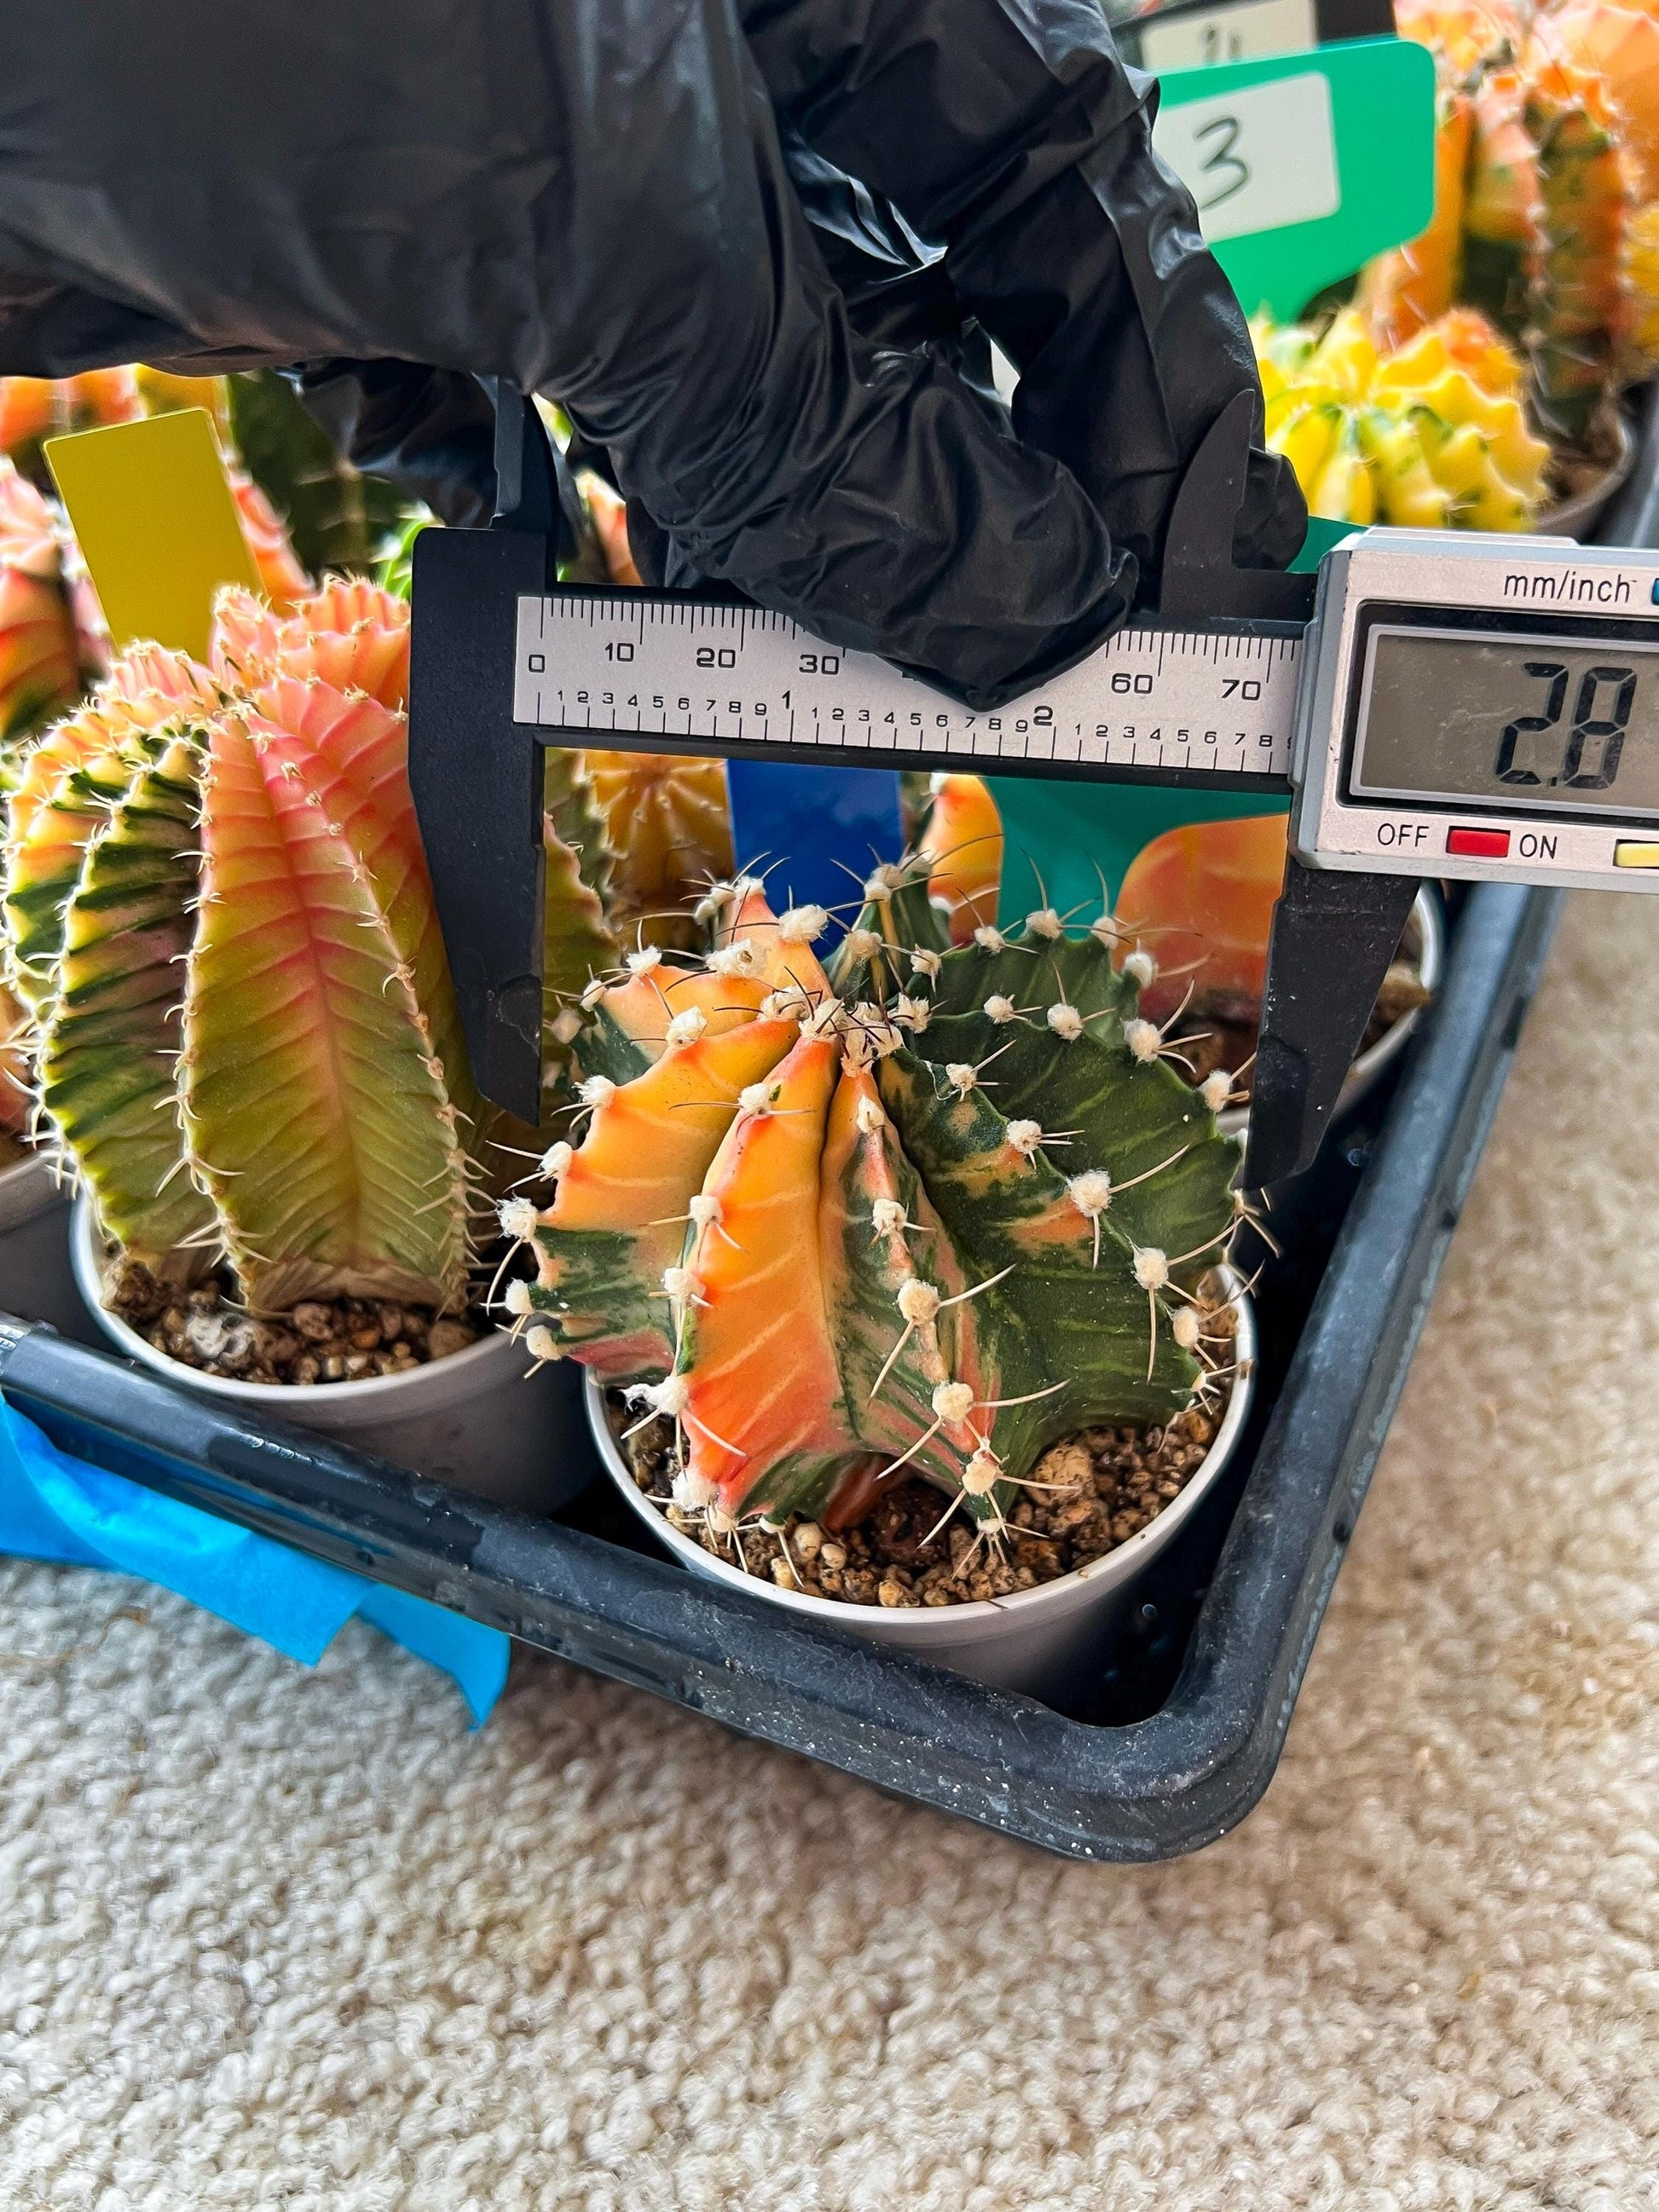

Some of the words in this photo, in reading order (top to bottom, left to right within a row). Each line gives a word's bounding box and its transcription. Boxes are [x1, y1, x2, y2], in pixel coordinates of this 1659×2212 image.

[1194, 116, 1250, 211] 3
[1503, 569, 1631, 604] mm/inch
[528, 654, 546, 673] 0
[604, 642, 635, 662] 10
[696, 647, 737, 669] 20
[799, 654, 840, 676] 30
[1111, 673, 1153, 695] 60
[1221, 679, 1262, 702] 70
[577, 690, 589, 704] 2
[602, 692, 614, 705] 3
[627, 694, 639, 707] 4
[652, 695, 664, 708] 5
[678, 697, 690, 711] 6
[706, 699, 717, 712] 7
[728, 701, 742, 713] 8
[754, 702, 767, 716] 9
[781, 690, 791, 710] 1
[831, 707, 845, 721] 2
[858, 709, 870, 722] 3
[883, 711, 895, 725] 4
[910, 713, 922, 726] 5
[935, 714, 949, 728] 6
[965, 715, 976, 729] 7
[988, 717, 1003, 731] 8
[1014, 719, 1028, 733] 9
[1032, 705, 1054, 727] 2
[1095, 724, 1108, 737] 2
[1123, 725, 1136, 738] 3
[1149, 728, 1161, 741] 4
[1176, 729, 1189, 742] 5
[1204, 731, 1217, 744] 6
[1234, 732, 1246, 745] 7
[1258, 734, 1274, 748] 8
[1494, 661, 1638, 789] 2.8
[1377, 823, 1430, 847] OFF
[1519, 834, 1558, 860] ON
